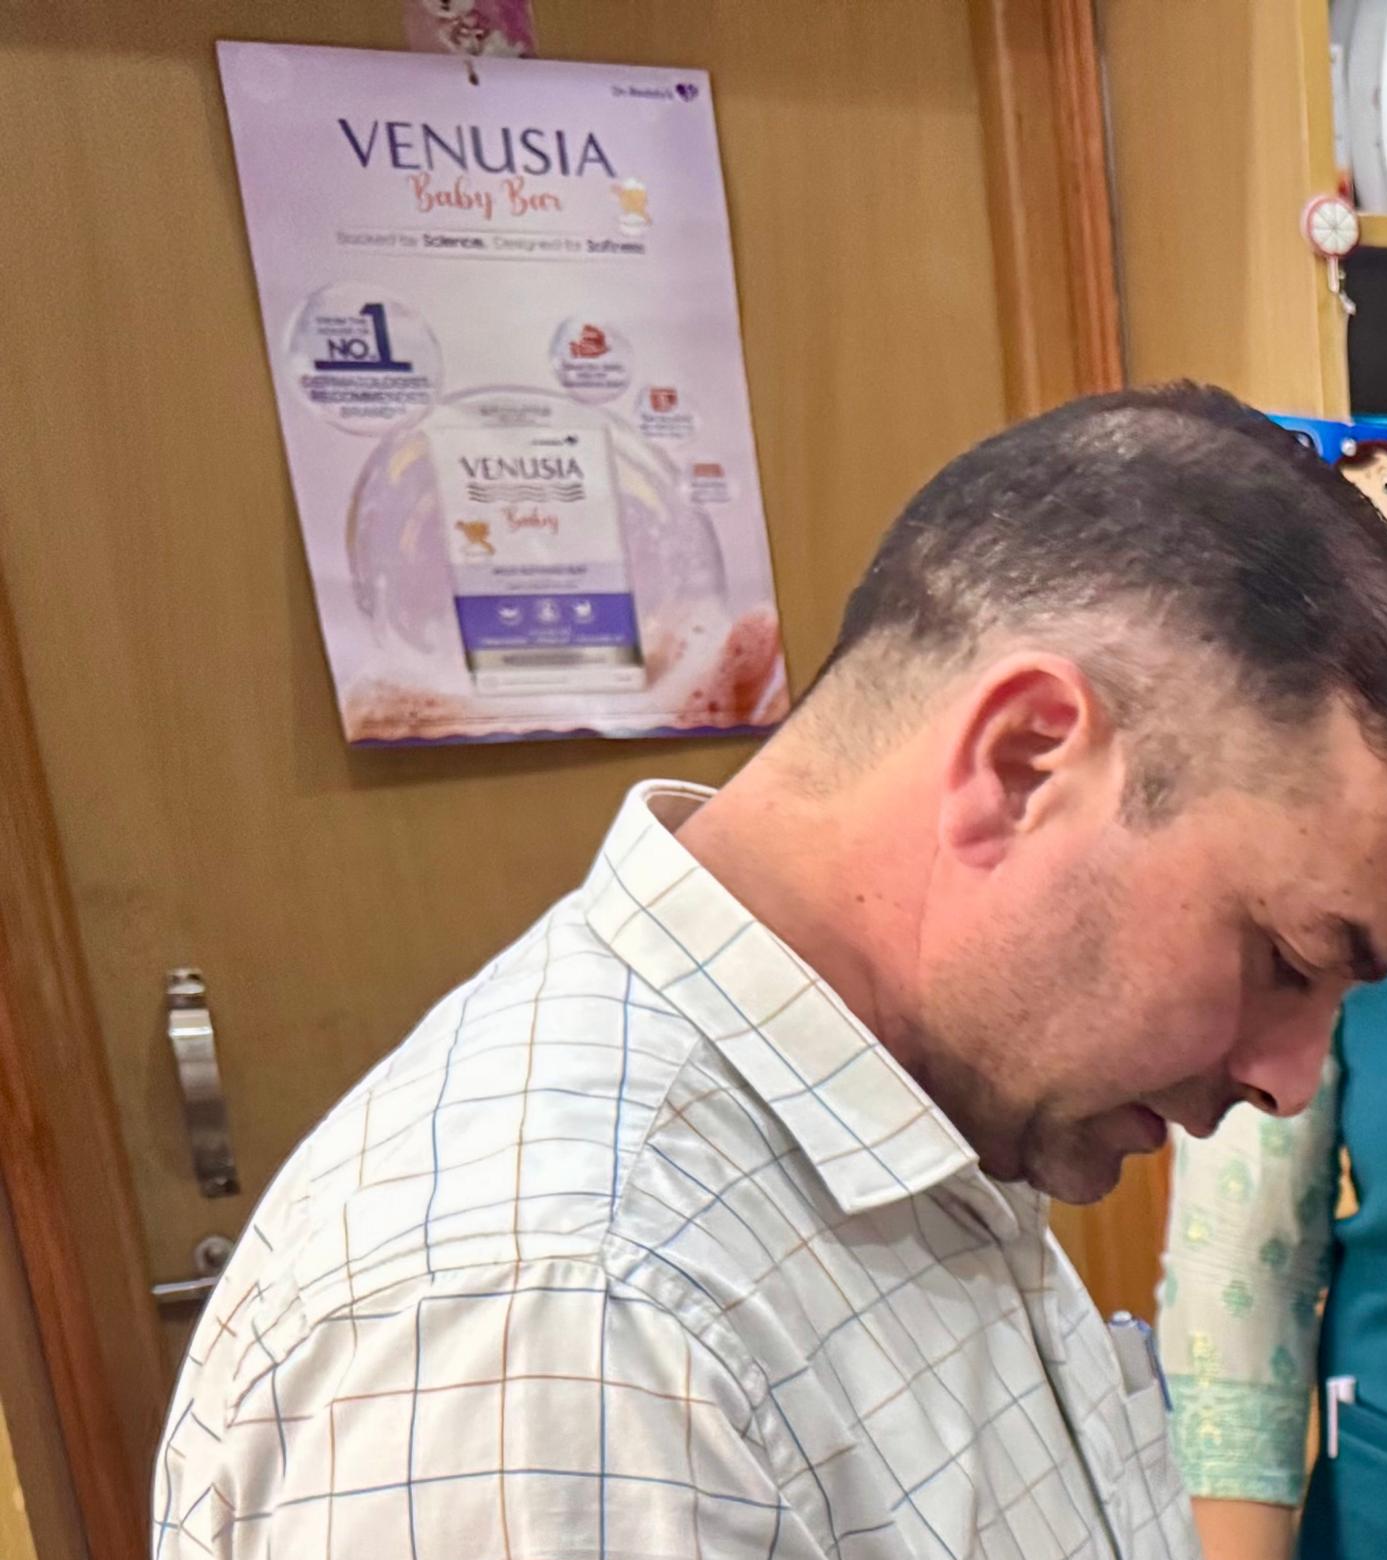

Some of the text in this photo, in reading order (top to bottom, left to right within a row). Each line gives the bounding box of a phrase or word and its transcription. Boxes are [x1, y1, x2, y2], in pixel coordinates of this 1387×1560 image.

[338, 118, 616, 179] VENUSIA
[407, 173, 493, 221] Baby
[459, 457, 584, 480] VENUSIA
